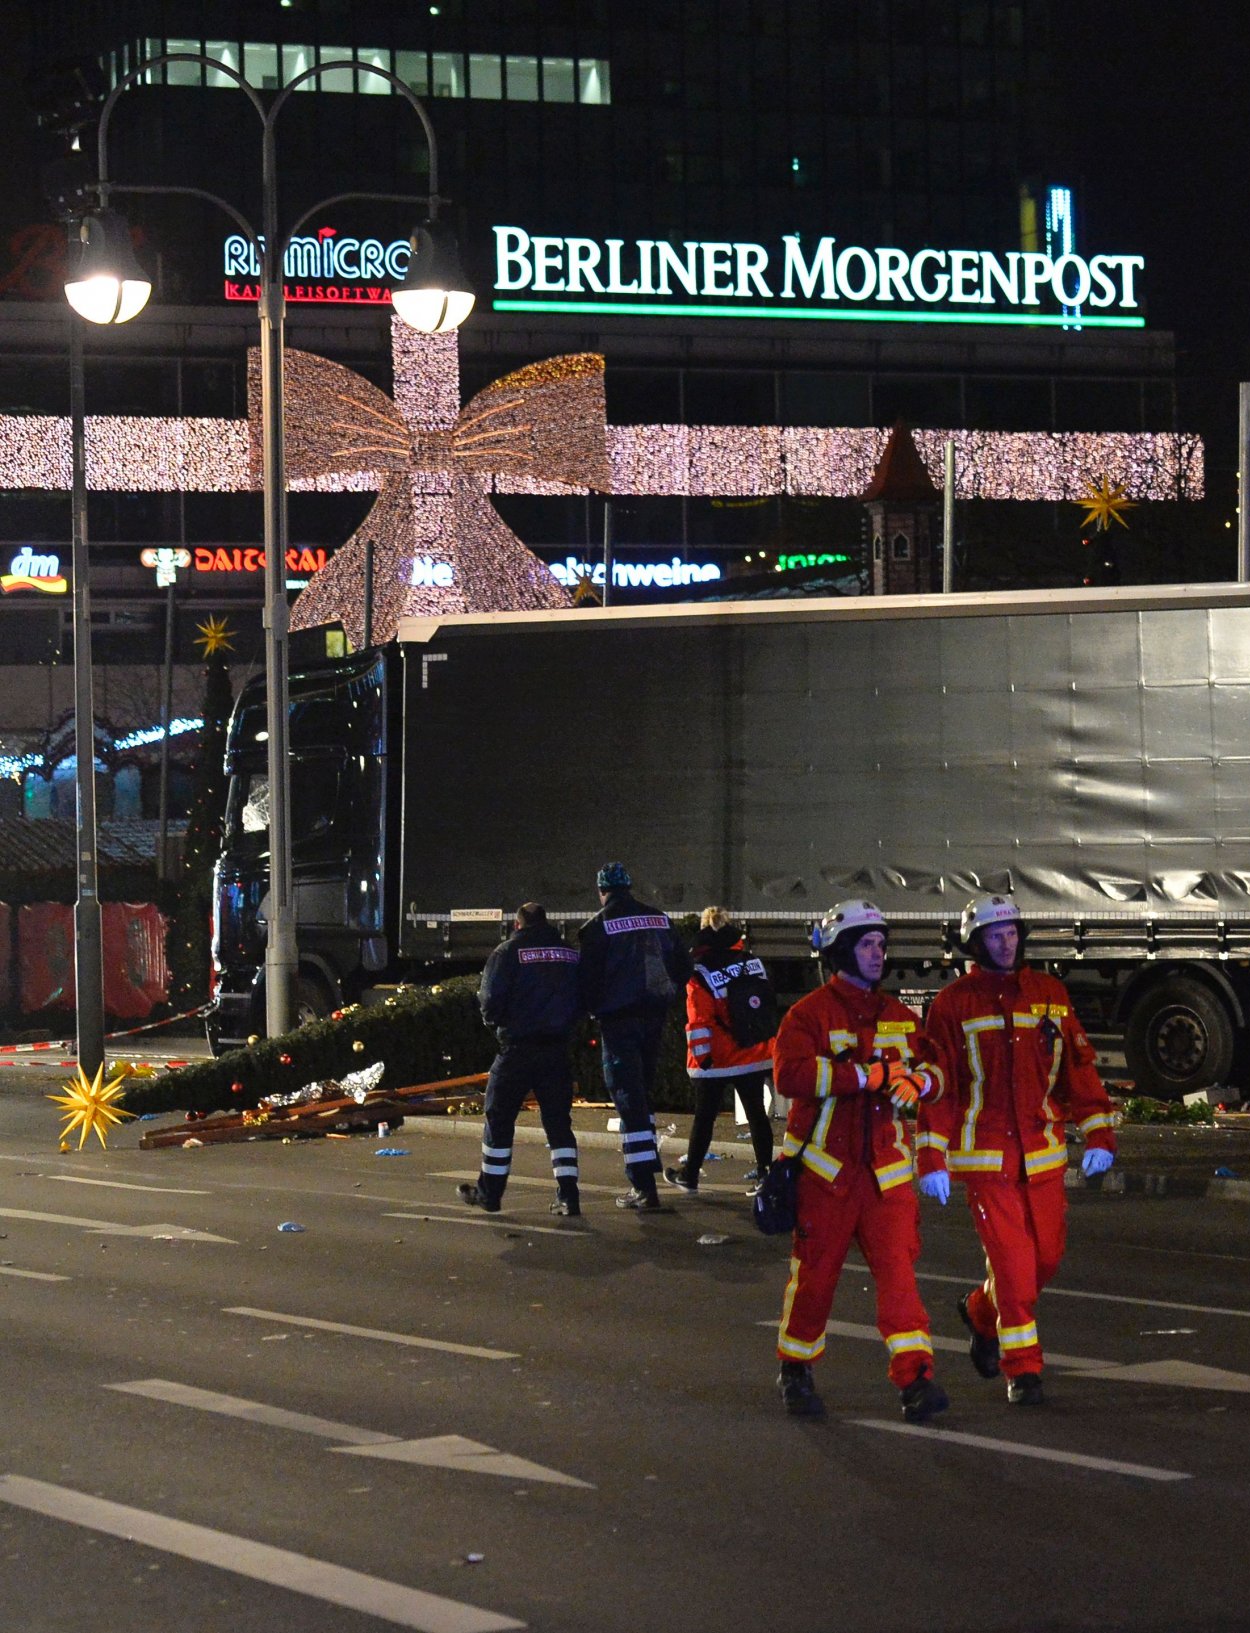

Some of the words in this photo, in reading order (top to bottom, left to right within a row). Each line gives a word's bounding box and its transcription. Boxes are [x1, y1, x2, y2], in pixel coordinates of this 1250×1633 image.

[493, 226, 774, 299] BERLINER
[781, 236, 1145, 309] MORGENPOST
[10, 546, 60, 578] dm
